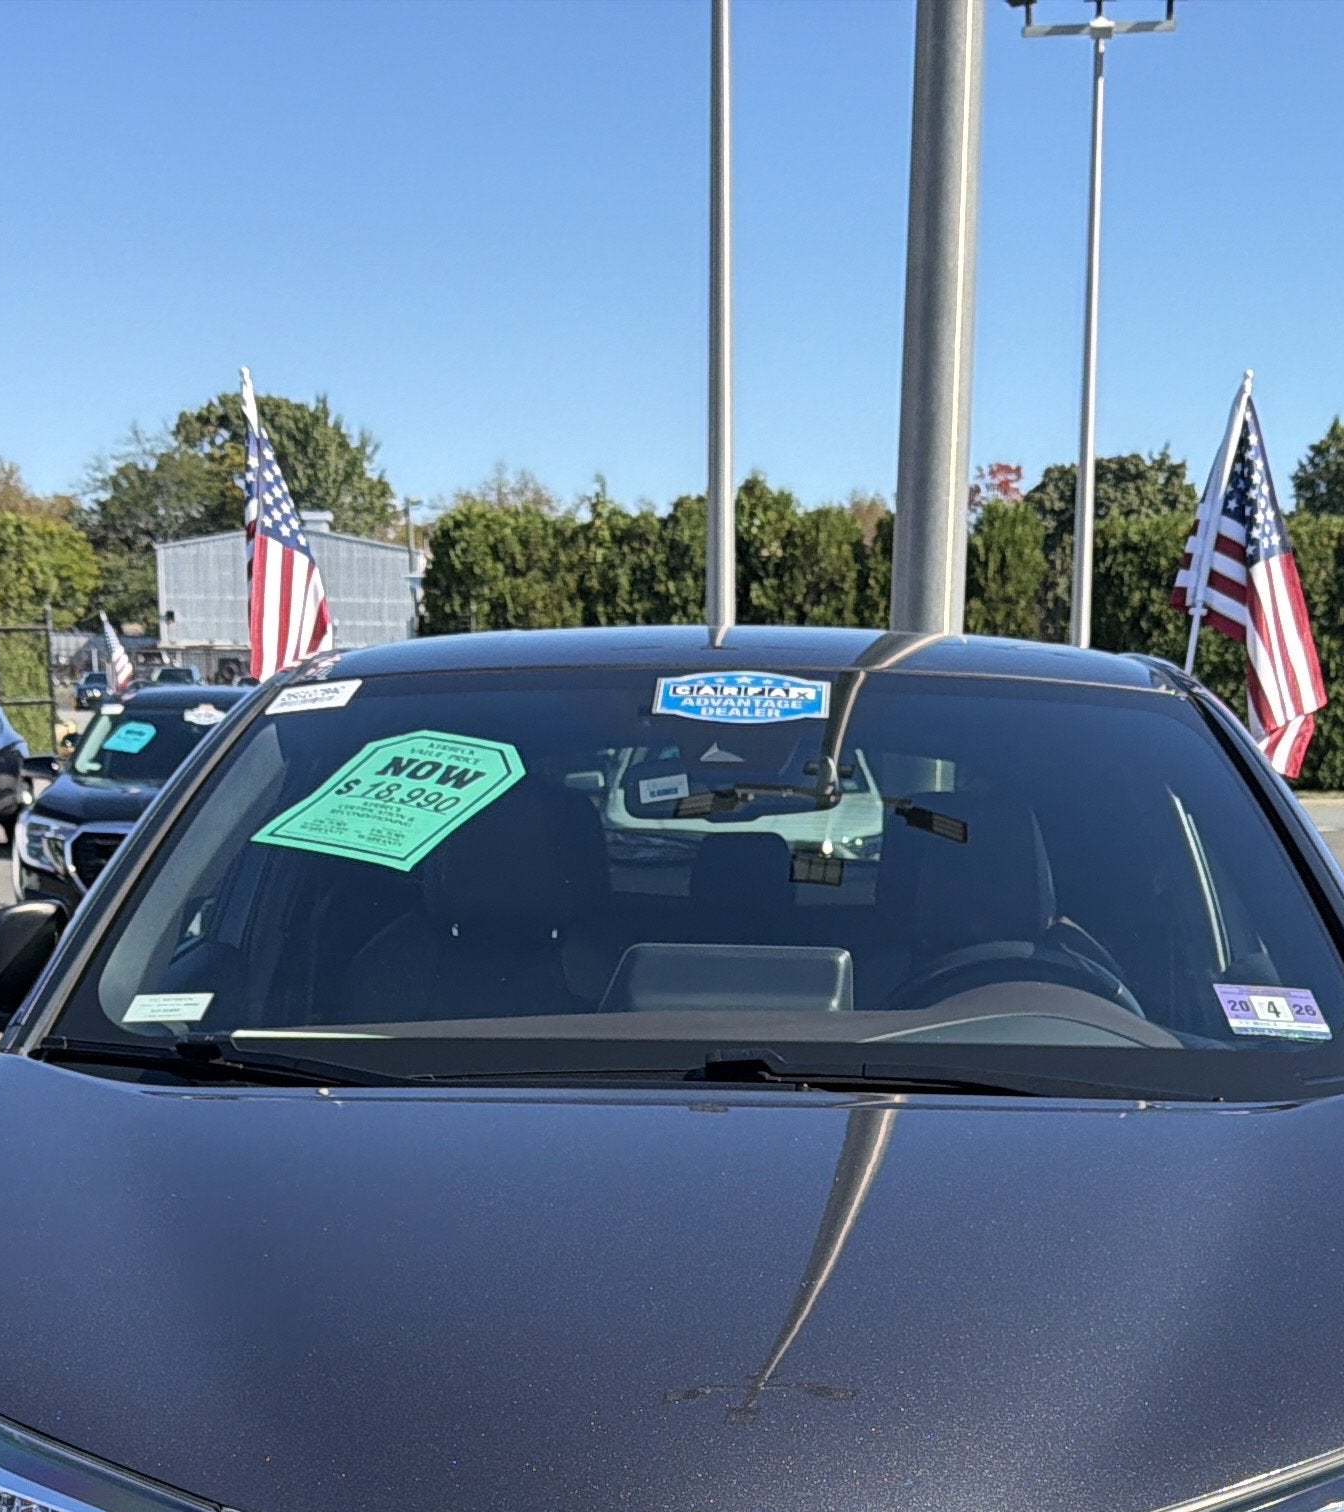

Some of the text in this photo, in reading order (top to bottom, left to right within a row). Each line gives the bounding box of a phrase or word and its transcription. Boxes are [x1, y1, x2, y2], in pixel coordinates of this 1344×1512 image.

[673, 685, 816, 700] CARFAX
[681, 697, 803, 709] ADVANTAGE
[701, 707, 781, 718] DEALER
[375, 756, 486, 790] NOW
[1227, 999, 1317, 1018] 20 4 26
